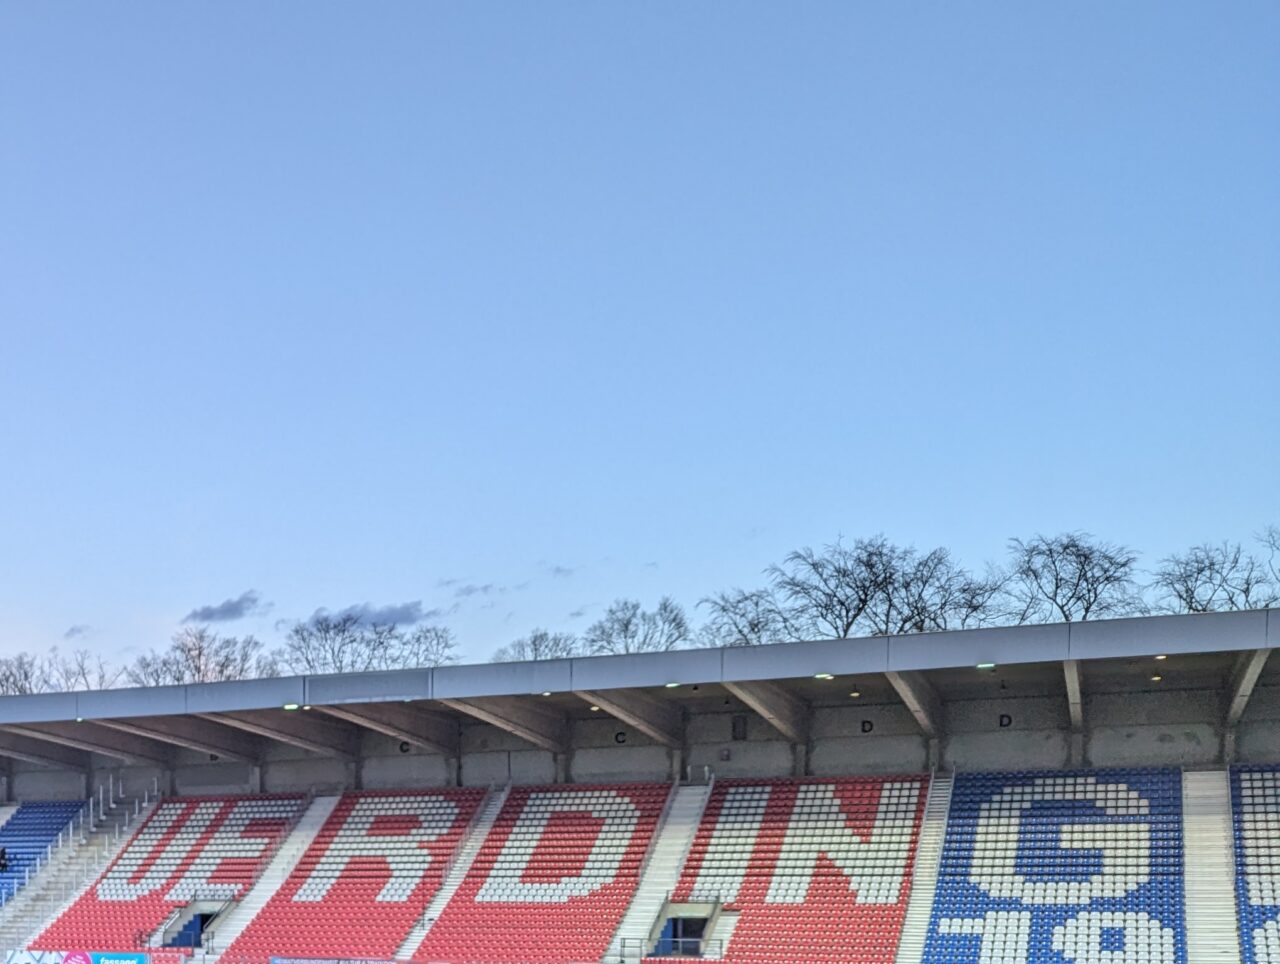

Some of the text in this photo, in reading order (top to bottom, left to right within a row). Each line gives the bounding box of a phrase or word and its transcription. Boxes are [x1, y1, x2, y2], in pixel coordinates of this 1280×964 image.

[861, 720, 874, 733] D
[999, 714, 1012, 728] D
[614, 731, 626, 745] C
[399, 741, 410, 754] C
